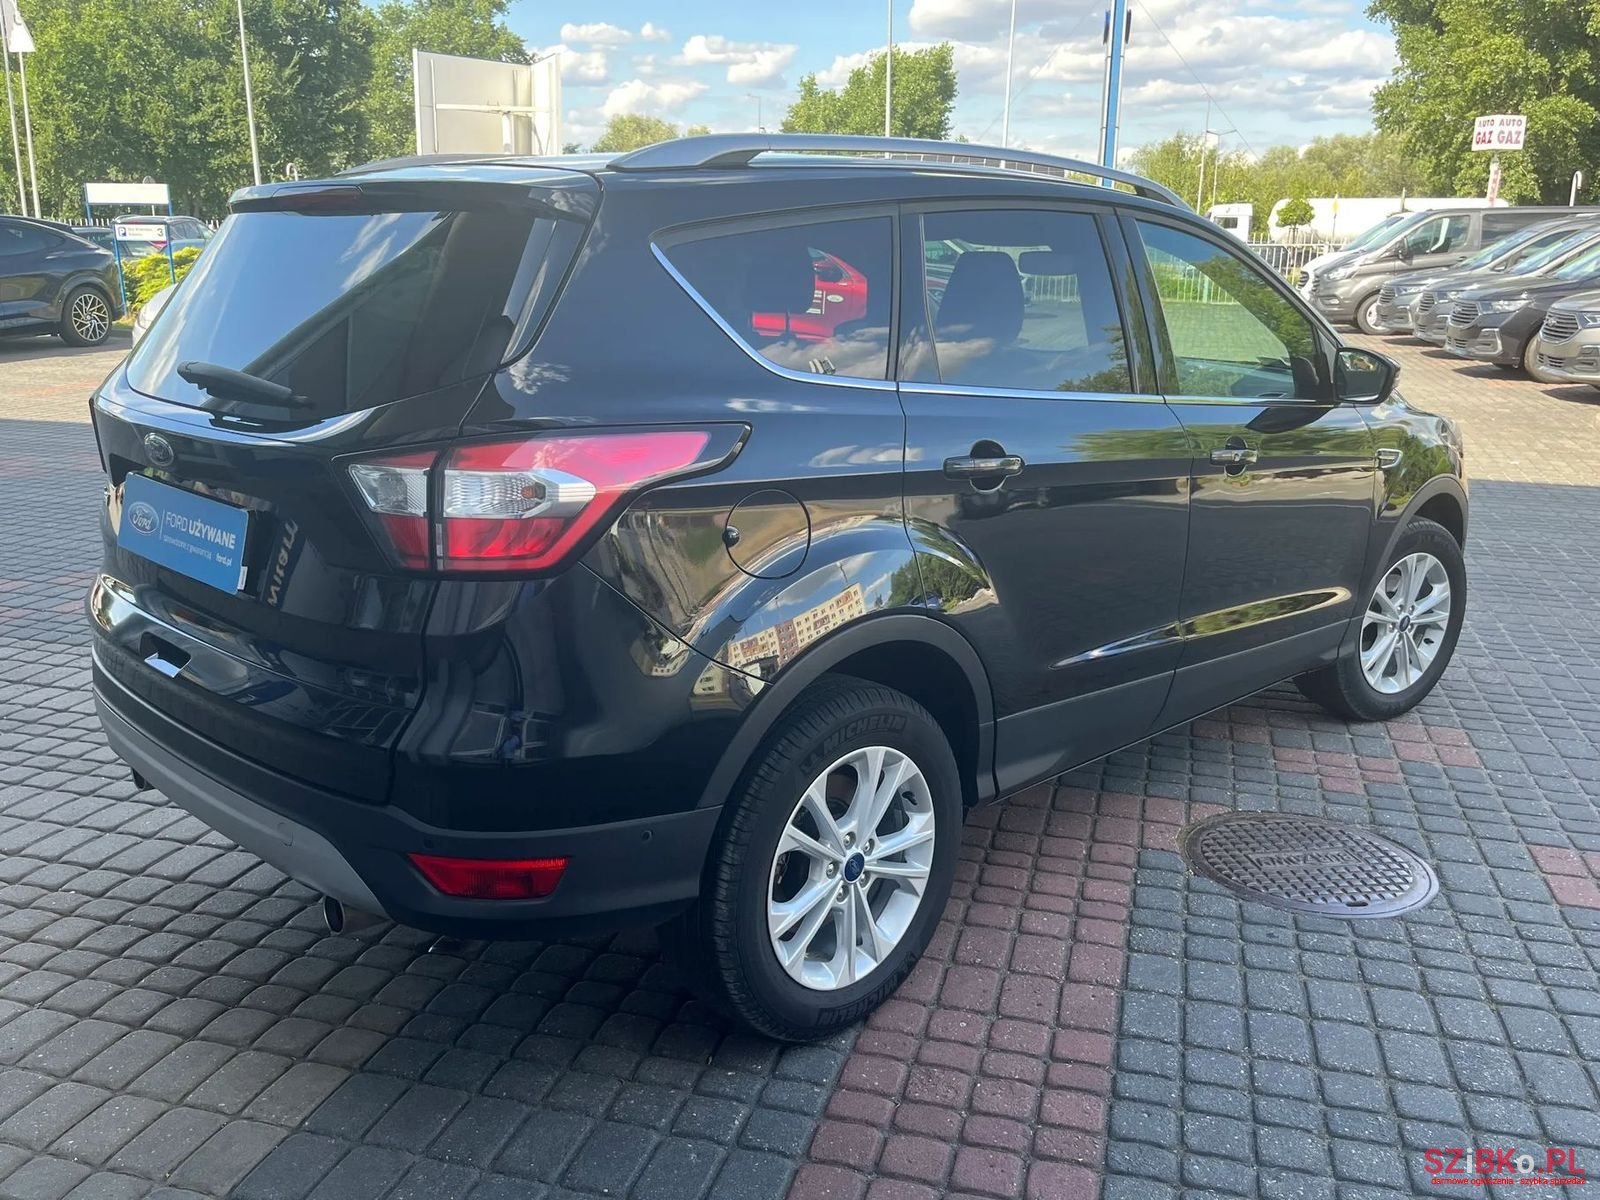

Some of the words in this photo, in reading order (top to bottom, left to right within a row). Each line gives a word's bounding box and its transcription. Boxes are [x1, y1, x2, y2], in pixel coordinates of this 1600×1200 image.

[1499, 118, 1523, 127] AUTO
[1475, 130, 1494, 145] GAZ
[1497, 130, 1522, 145] GAZ
[157, 228, 164, 237] 3
[165, 511, 188, 532] FORD
[188, 518, 236, 550] UŻYWANE
[824, 714, 907, 754] MICHELIN
